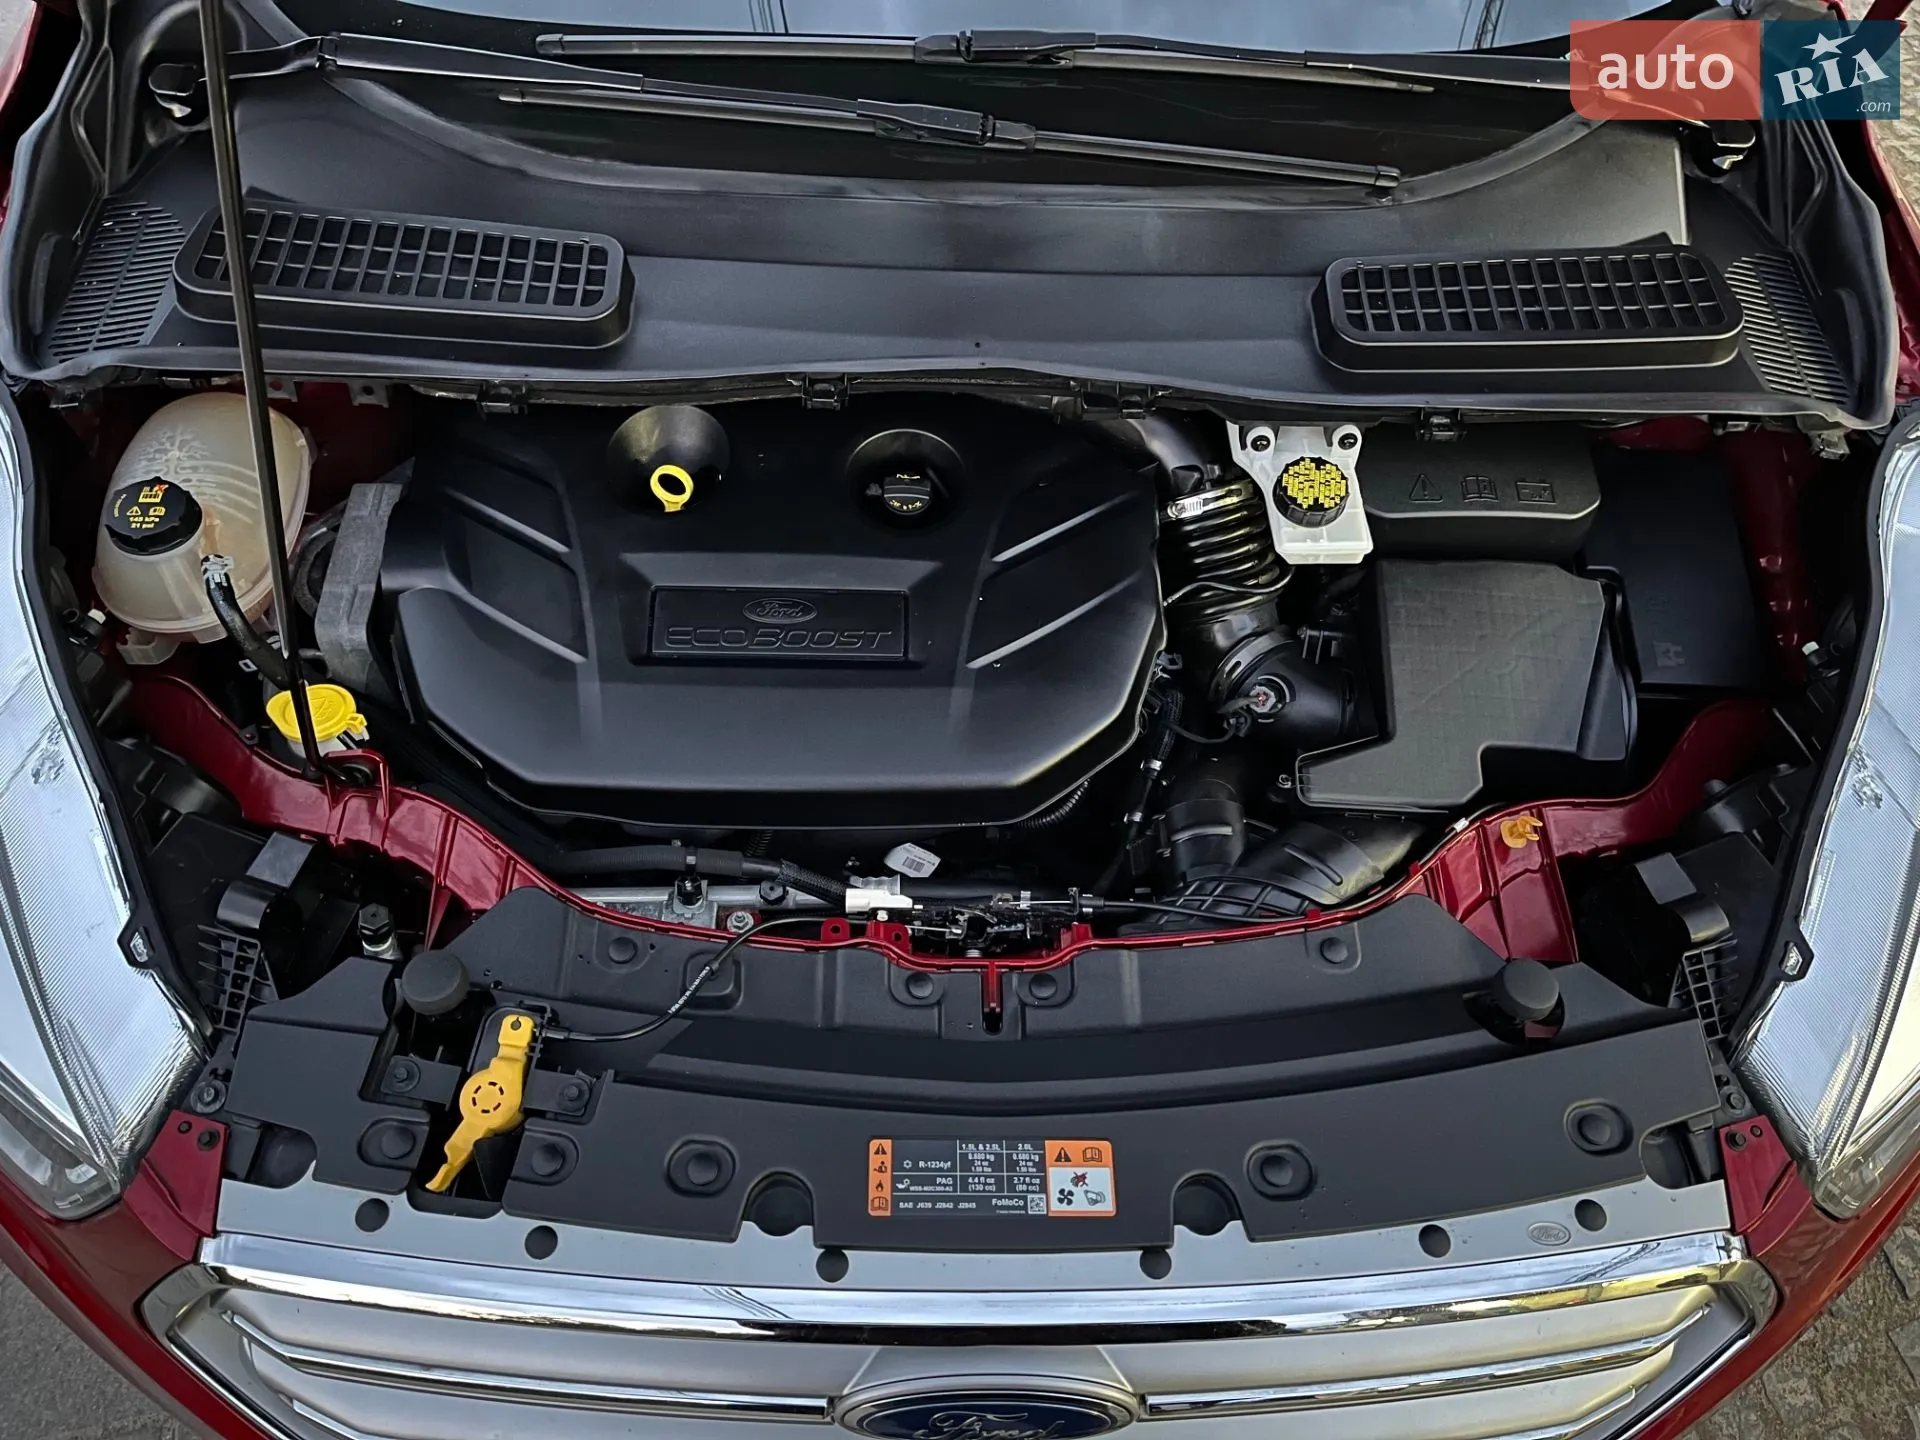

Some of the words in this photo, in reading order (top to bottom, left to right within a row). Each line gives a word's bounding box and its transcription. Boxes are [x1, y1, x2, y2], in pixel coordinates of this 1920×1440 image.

[756, 600, 803, 618] Ford
[665, 627, 893, 649] ECOBOOST
[918, 1160, 952, 1170] R-1234yf
[936, 1177, 953, 1185] PAG
[968, 1176, 979, 1184] 4.4
[991, 1198, 1025, 1206] FoMoCo
